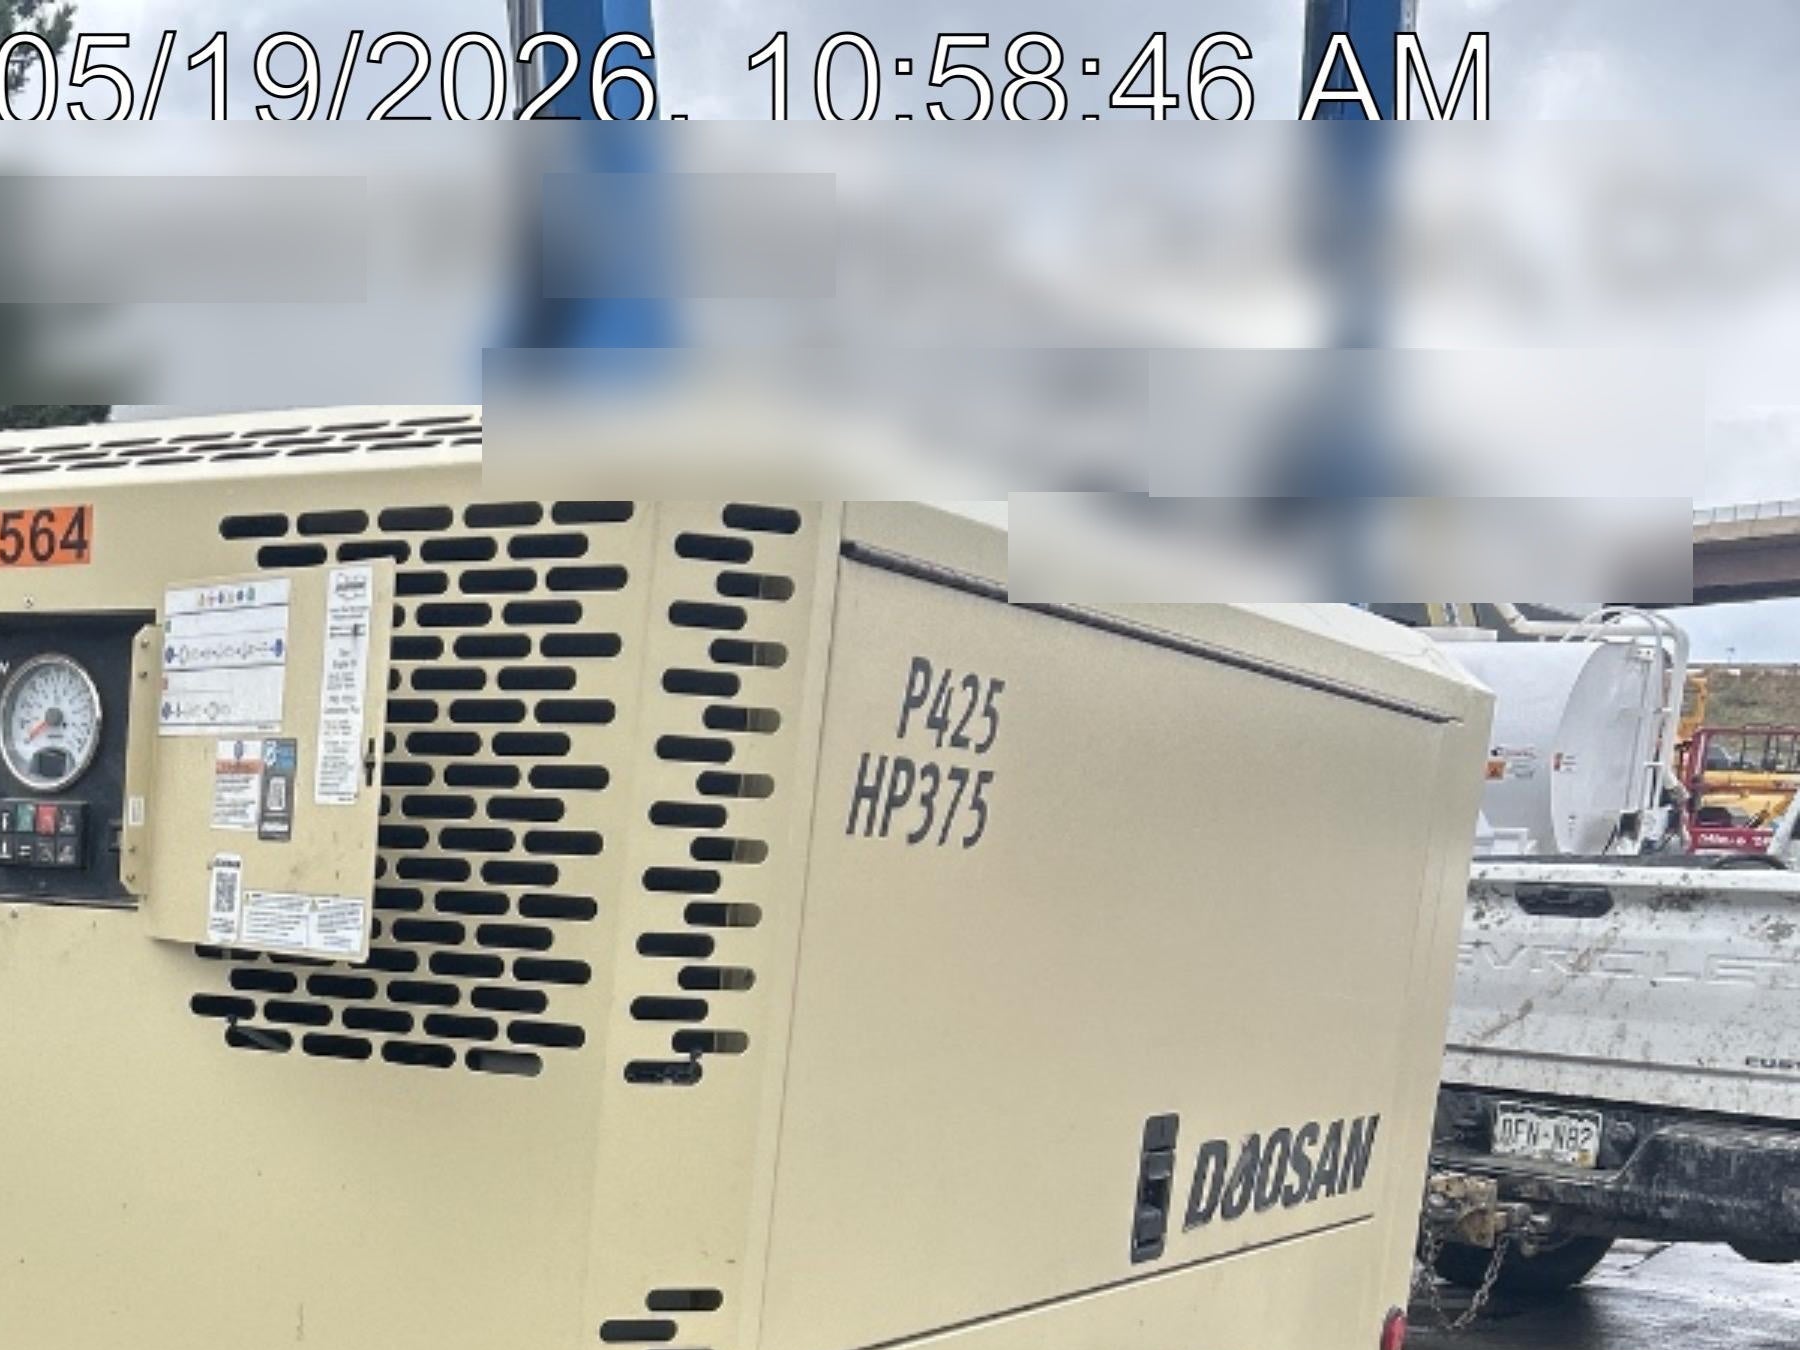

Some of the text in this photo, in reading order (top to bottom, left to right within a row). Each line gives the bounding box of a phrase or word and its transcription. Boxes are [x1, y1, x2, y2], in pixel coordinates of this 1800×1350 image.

[896, 655, 1005, 753] P425
[845, 752, 994, 849] HP375
[1182, 1112, 1381, 1234] DOOSAN
